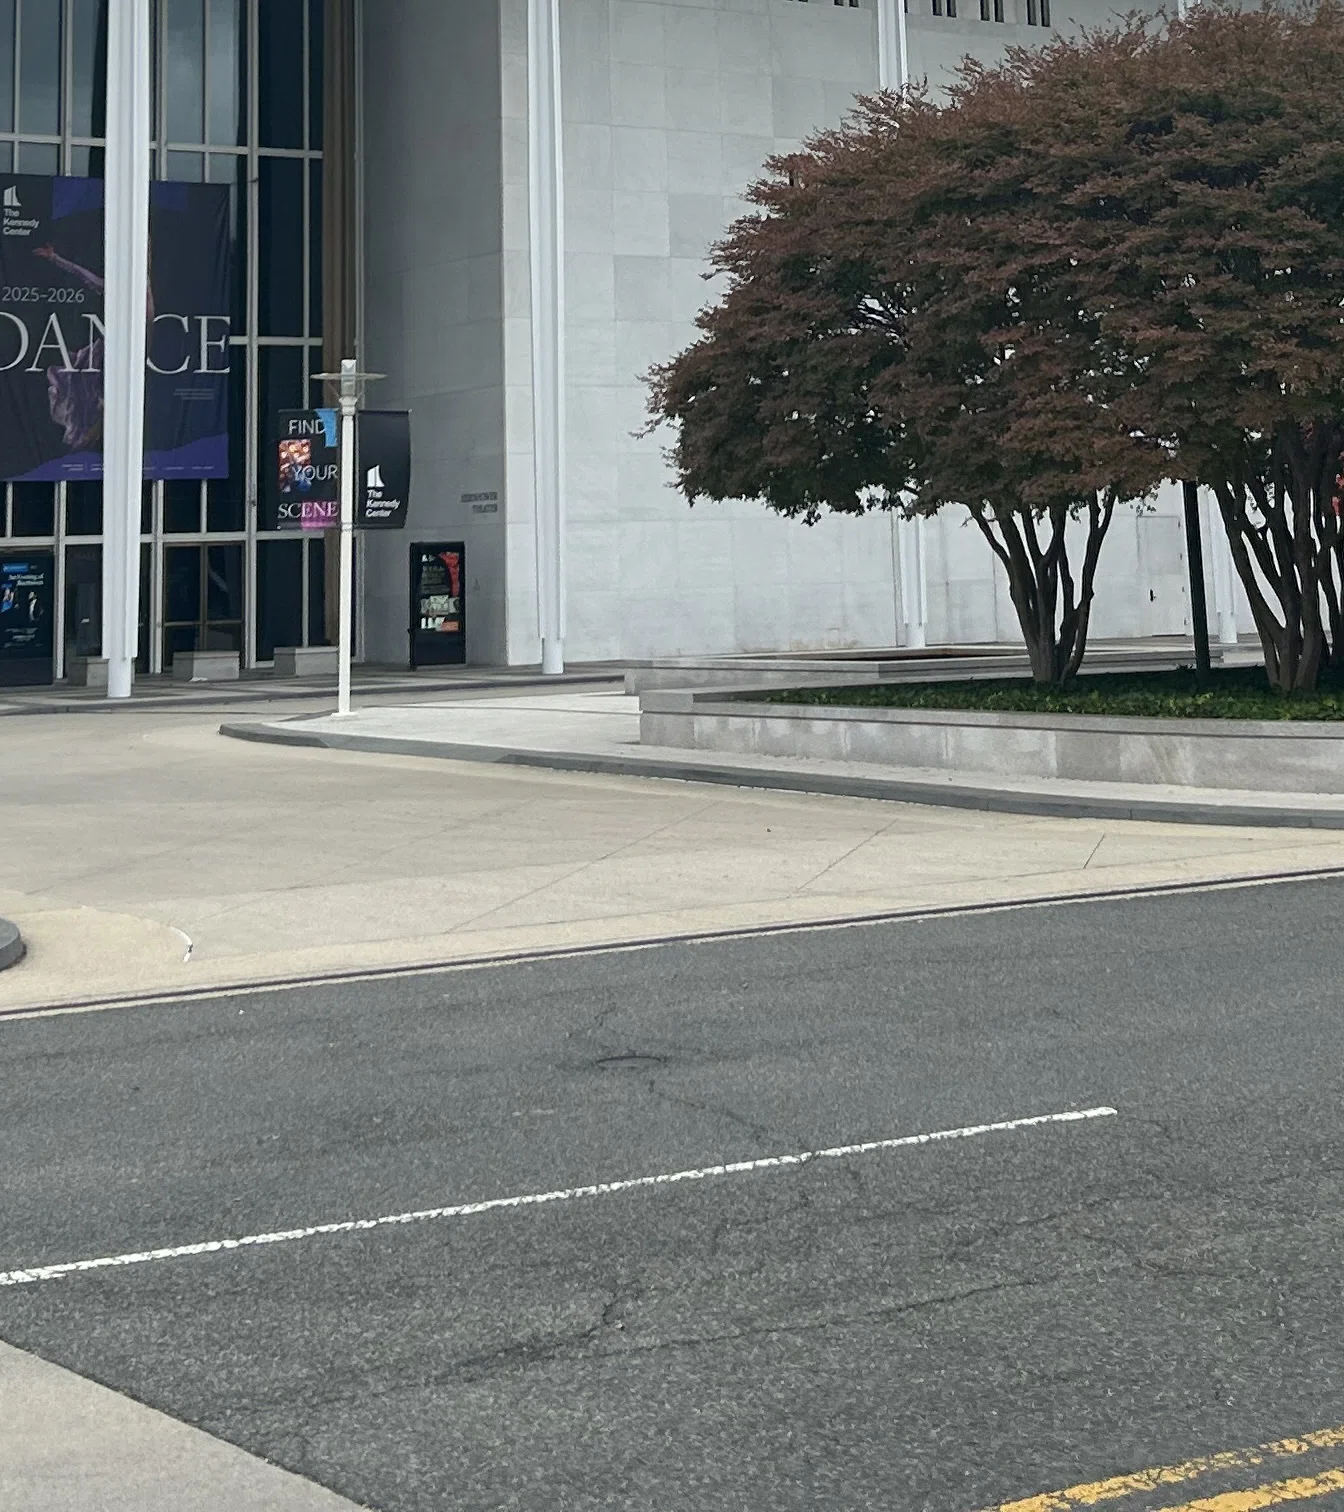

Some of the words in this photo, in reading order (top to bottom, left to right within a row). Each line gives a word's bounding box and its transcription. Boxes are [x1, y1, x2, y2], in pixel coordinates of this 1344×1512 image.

[4, 208, 20, 217] The
[3, 217, 39, 229] Kennedy
[2, 226, 31, 236] Center
[288, 419, 326, 435] FIND
[292, 464, 338, 481] YOUR
[367, 489, 383, 498] The
[277, 501, 338, 519] SCENE
[366, 499, 400, 510] Kennedy
[365, 509, 392, 518] Center
